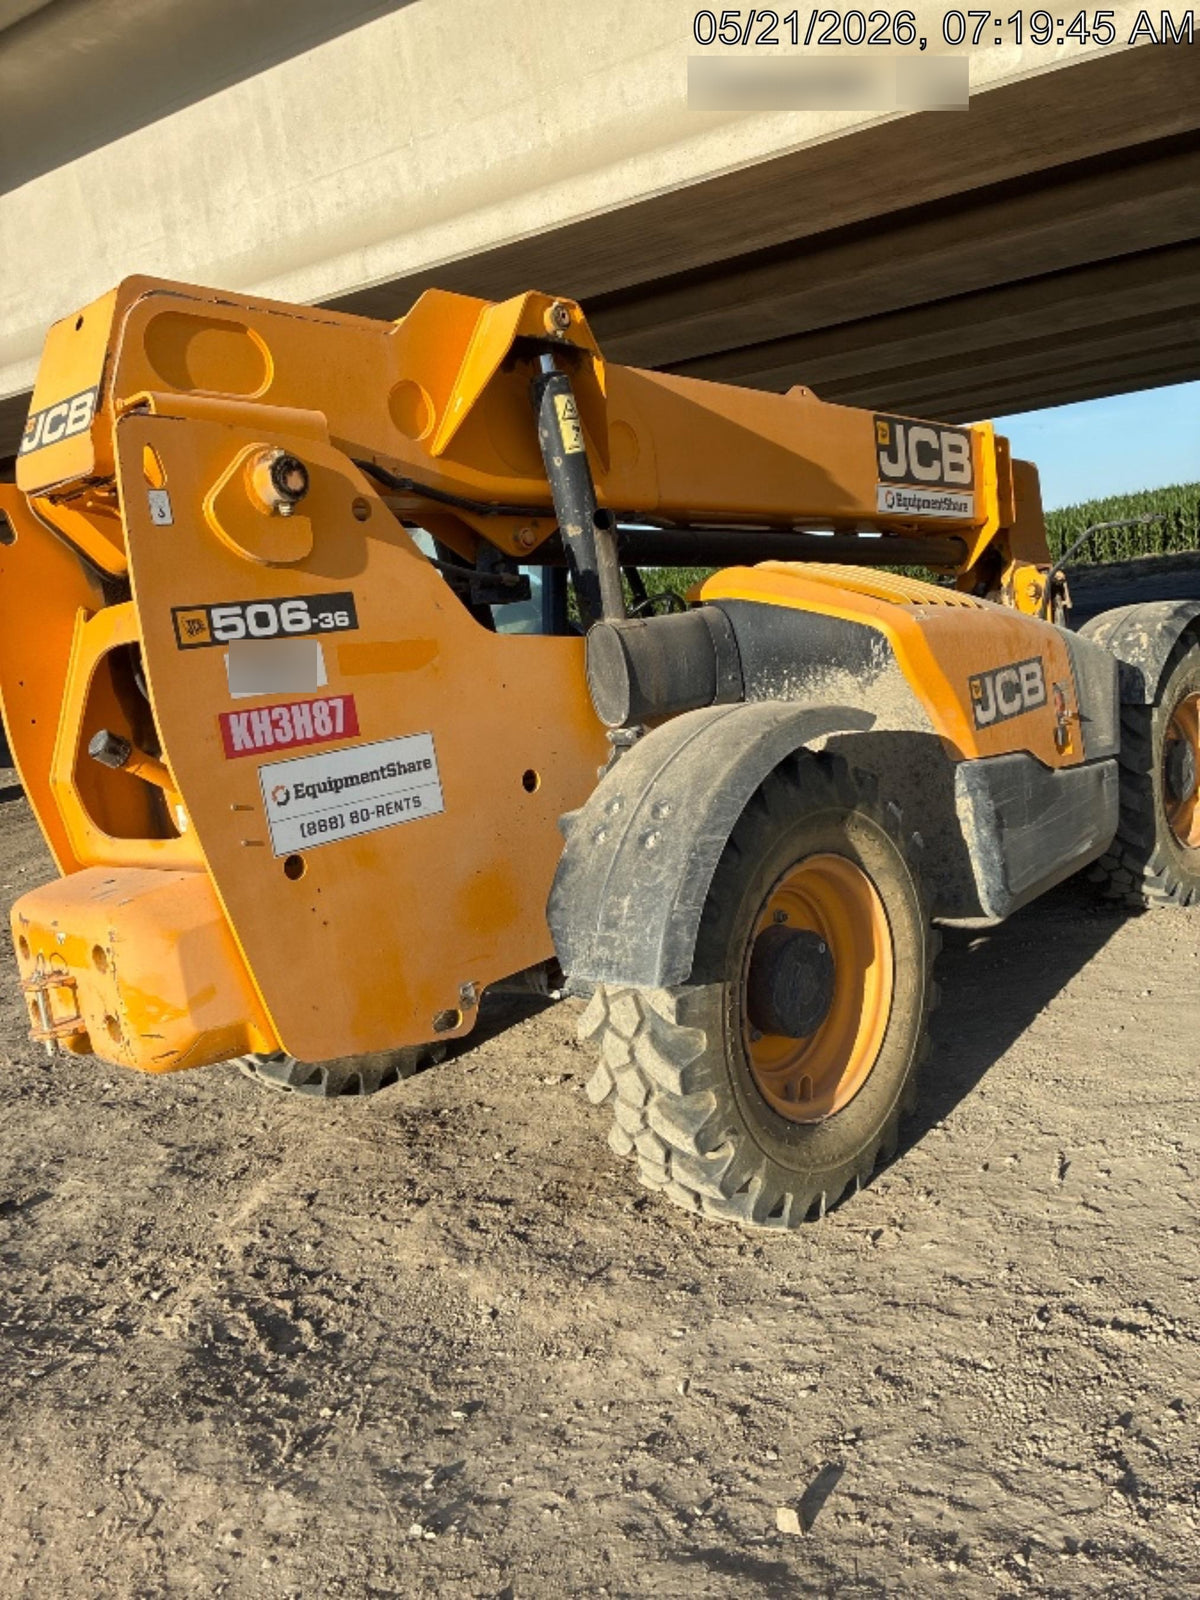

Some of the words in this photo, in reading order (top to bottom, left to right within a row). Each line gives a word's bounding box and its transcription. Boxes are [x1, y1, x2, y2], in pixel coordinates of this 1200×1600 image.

[20, 391, 95, 453] JCB
[879, 424, 972, 484] JCB
[895, 492, 968, 512] EquipmentShare
[211, 600, 350, 641] 506-36
[975, 662, 1046, 724] JCB
[228, 698, 344, 751] KH3H87
[292, 758, 433, 800] EquipmentShare
[300, 814, 346, 839] (888)
[349, 795, 422, 825] 80-RENTS
